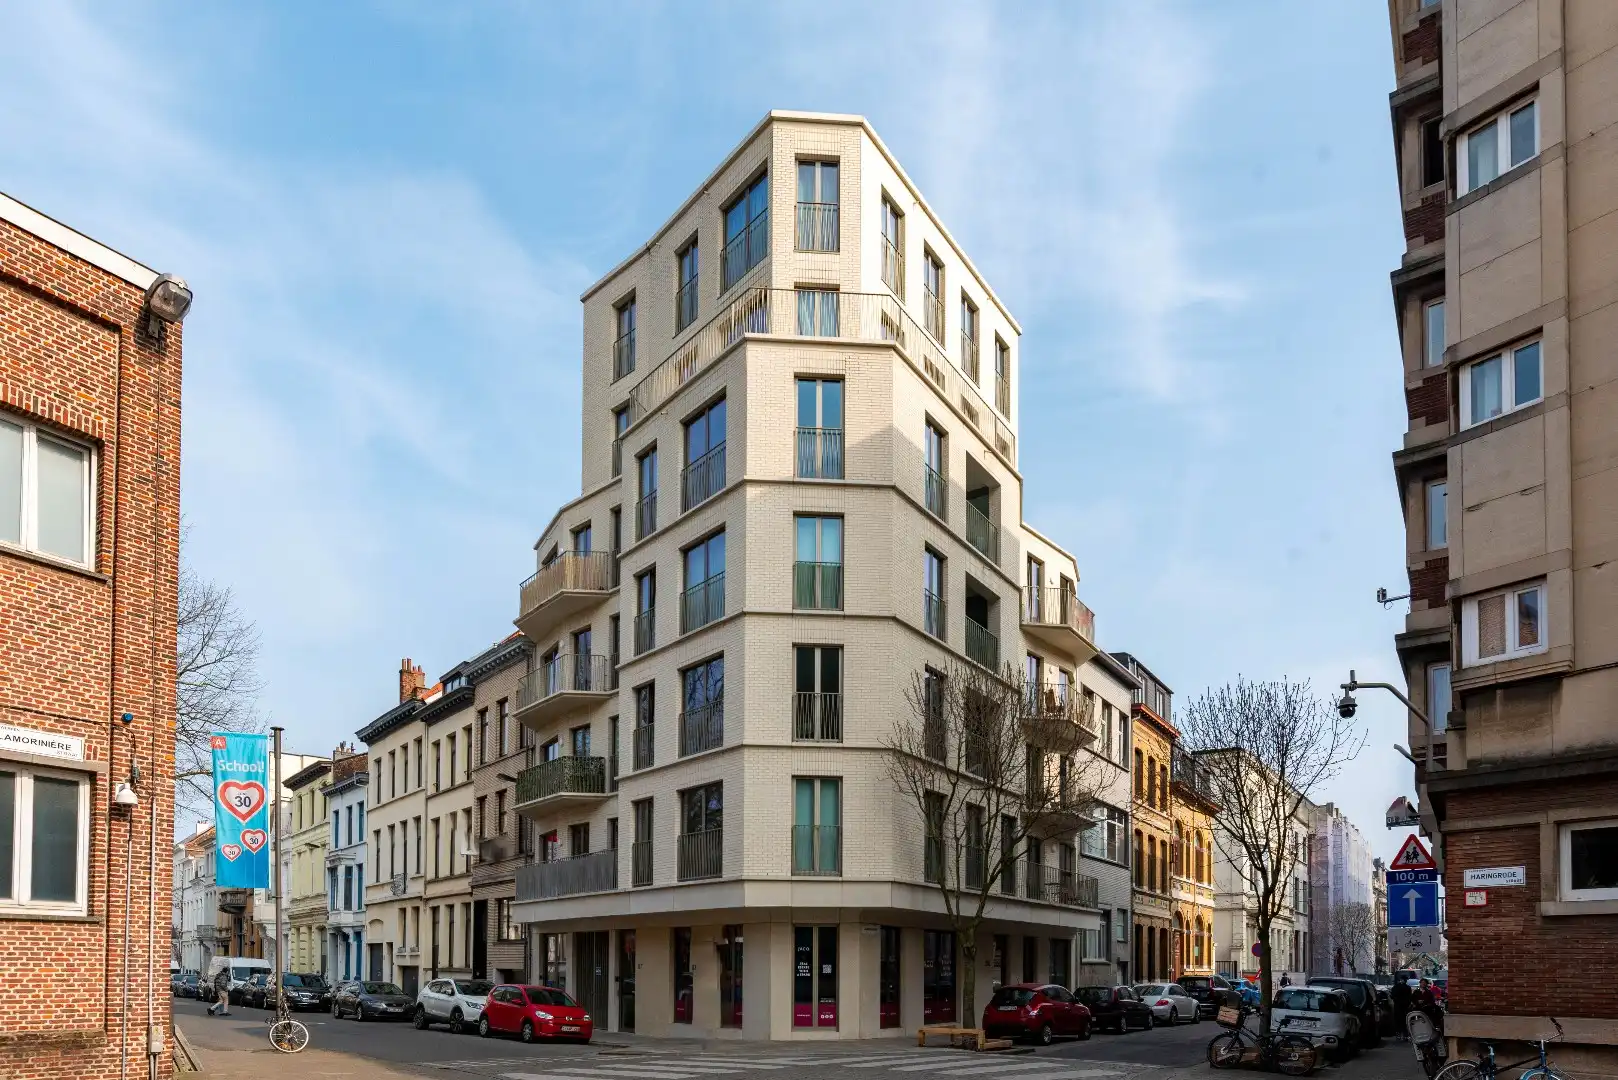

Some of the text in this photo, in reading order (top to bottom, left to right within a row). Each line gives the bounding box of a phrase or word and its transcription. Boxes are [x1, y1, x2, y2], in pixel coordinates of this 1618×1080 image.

[218, 759, 265, 773] School!
[234, 796, 252, 808] 30
[249, 837, 259, 845] 30
[1395, 872, 1415, 881] 100
[1470, 871, 1517, 880] HARINGRODE
